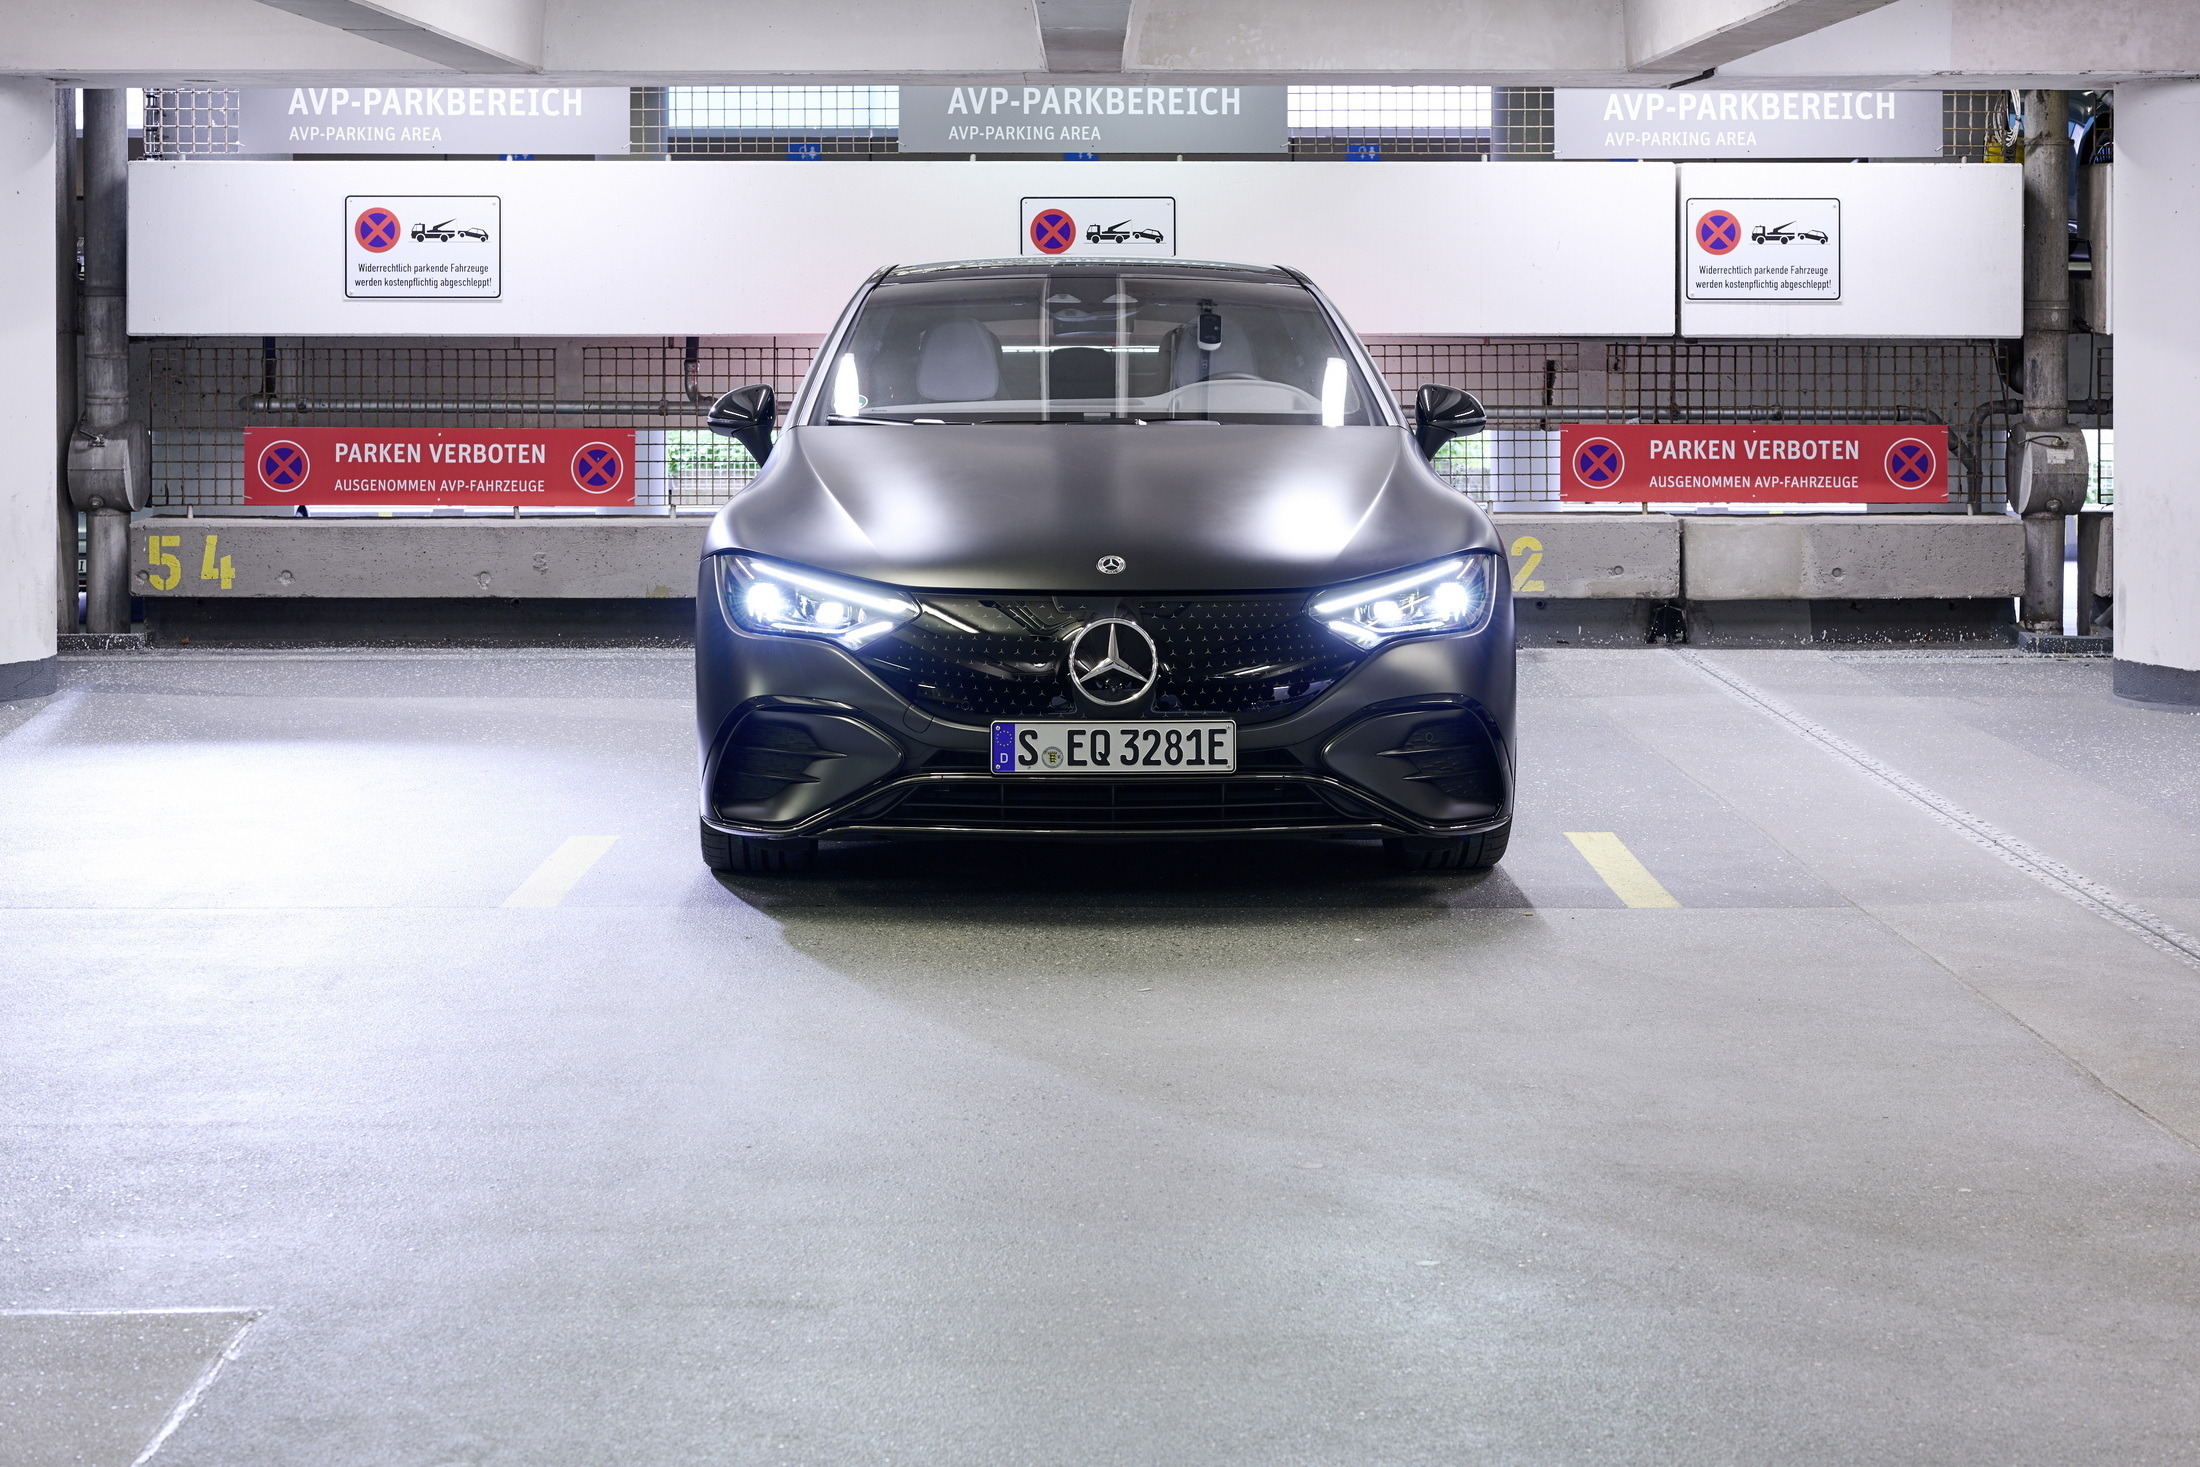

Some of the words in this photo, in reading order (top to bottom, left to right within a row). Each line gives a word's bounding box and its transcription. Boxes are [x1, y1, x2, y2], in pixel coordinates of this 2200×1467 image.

[288, 87, 582, 116] AVP-PARKBEREICH
[947, 87, 1241, 115] AVP-PARKBEREICH
[1603, 92, 1896, 121] AVP-PARKBEREICH
[289, 126, 396, 142] AVP-PARKING
[400, 127, 443, 142] AREA
[948, 125, 1055, 141] AVP-PARKING
[1060, 126, 1101, 141] AREA
[1604, 131, 1711, 147] AVP-PARKING
[1715, 132, 1757, 147] AREA
[358, 263, 412, 273] Widerrechtlich
[413, 263, 449, 275] parkende
[450, 263, 489, 275] Fahrzeuge
[1699, 265, 1752, 275] Widerrechtlich
[1754, 265, 1789, 277] parkende
[1790, 265, 1829, 277] Fahrzeuge
[354, 277, 383, 287] werden
[384, 277, 439, 289] kostenpflichtig
[440, 277, 492, 289] abgeschleppt!
[1695, 279, 1723, 289] werden
[1724, 279, 1779, 291] kostenpflichtig
[1780, 279, 1832, 291] abgeschleppt!
[335, 443, 421, 463] PARKEN
[429, 443, 546, 464] VERBOTEN
[1650, 439, 1736, 460] PARKEN
[1743, 440, 1859, 460] VERBOTEN
[334, 479, 436, 492] AUSGENOMMEN
[440, 479, 545, 492] AVP-FAHRZEUGE
[1649, 475, 1751, 488] AUSGENOMMEN
[1754, 476, 1859, 488] AVP-FAHRZEUGE
[1511, 536, 1545, 592] 2
[1018, 729, 1038, 766] S
[1067, 729, 1111, 766] EQ
[1120, 729, 1229, 766] 3281E
[1000, 752, 1009, 764] D
